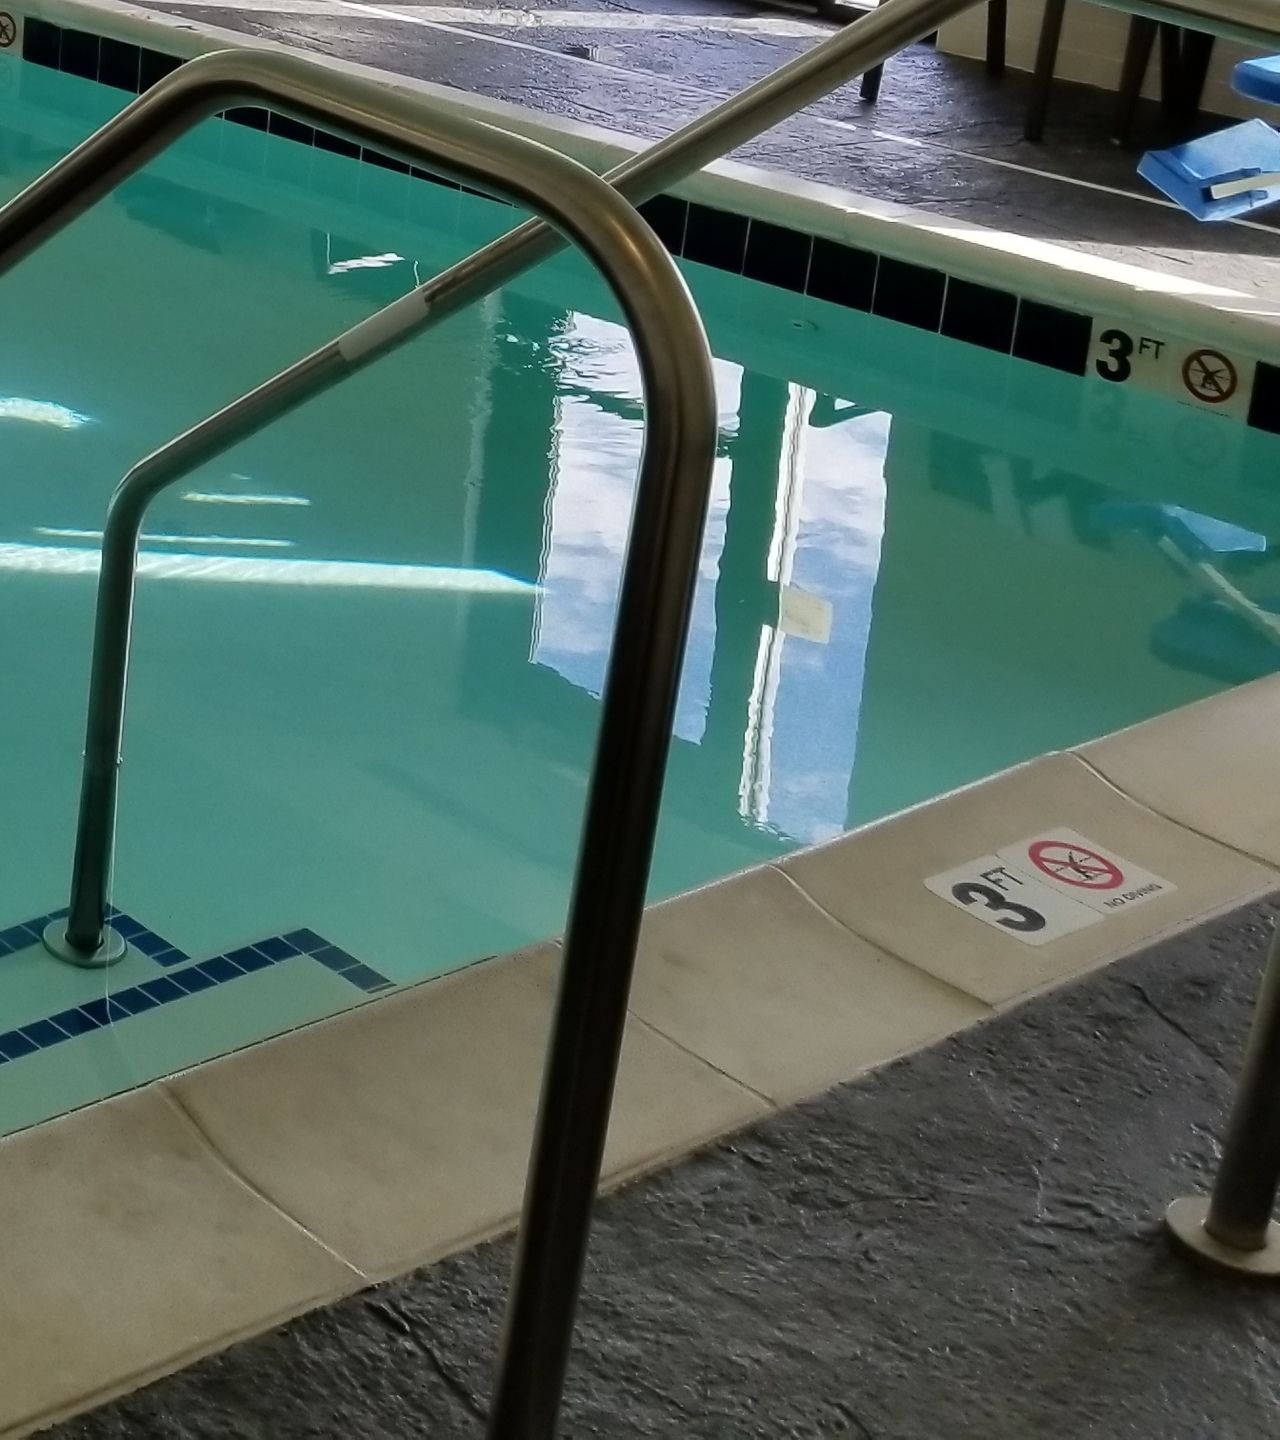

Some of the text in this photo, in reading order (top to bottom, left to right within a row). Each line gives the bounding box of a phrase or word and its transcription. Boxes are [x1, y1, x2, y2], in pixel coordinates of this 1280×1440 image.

[1095, 328, 1166, 383] 3 FT
[951, 866, 1047, 933] 3 FT
[1103, 882, 1162, 909] NO DIVING
